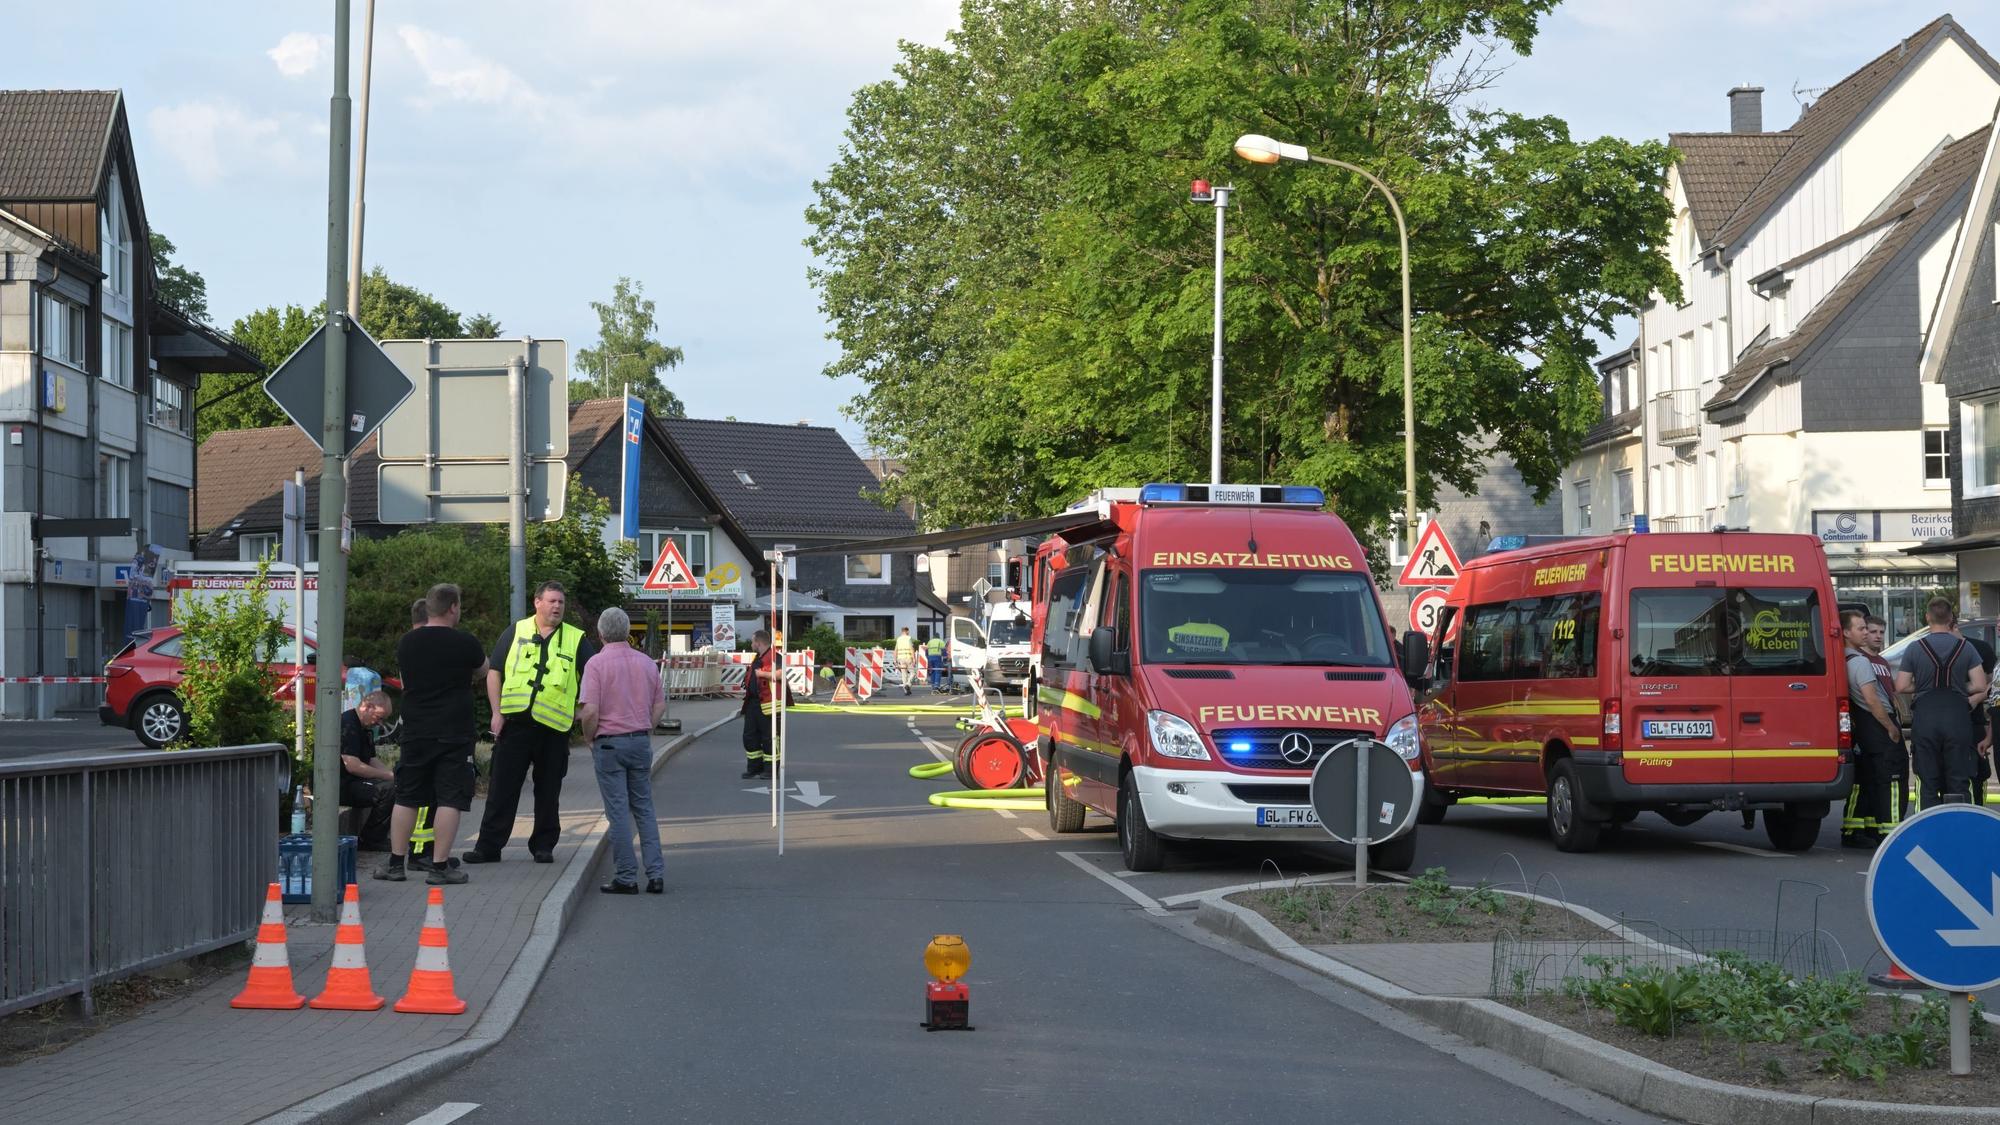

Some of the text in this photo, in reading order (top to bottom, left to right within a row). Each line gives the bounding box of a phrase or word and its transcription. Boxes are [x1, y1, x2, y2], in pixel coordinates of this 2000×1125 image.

[1215, 491, 1255, 501] FEUERWEHR
[1823, 533, 1868, 541] Continentale
[1912, 527, 1936, 536] Willi
[1153, 552, 1353, 569] EINSATZLEITUNG
[1650, 554, 1796, 573] FEUERWEHR
[1534, 563, 1587, 586] FEUERWEHR
[261, 580, 298, 589] OTRU
[306, 580, 318, 589] 11
[1558, 619, 1576, 640] 112
[1781, 629, 1808, 638] retten
[1762, 637, 1798, 649] Leben
[1200, 705, 1383, 726] FEUERWEHR
[1650, 722, 1712, 735] GL FW 6191
[1639, 758, 1673, 767] Pütting
[1265, 810, 1319, 822] GL FW 6
